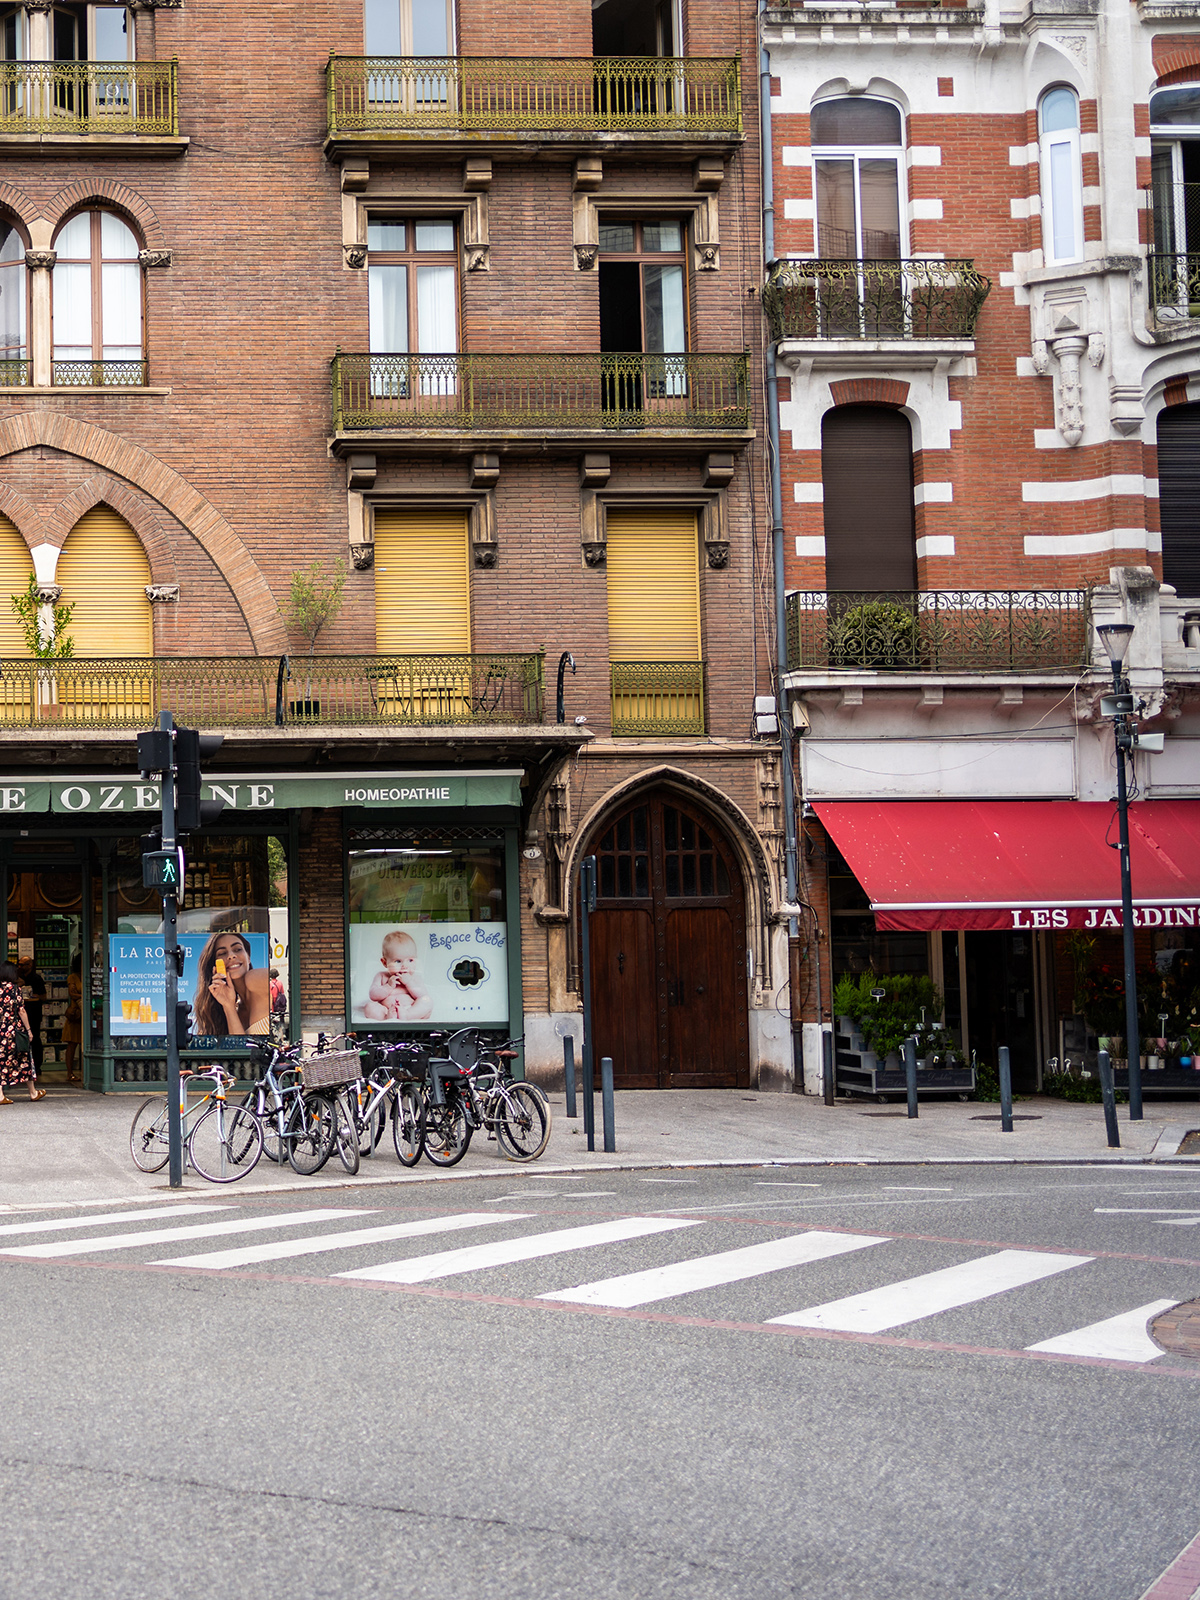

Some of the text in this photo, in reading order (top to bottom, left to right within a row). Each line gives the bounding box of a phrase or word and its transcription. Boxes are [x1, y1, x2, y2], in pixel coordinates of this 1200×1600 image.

[60, 784, 276, 811] OZENE
[344, 787, 450, 801] HOMEOPATHIE
[1011, 906, 1200, 929] LES JARDIN
[429, 927, 506, 950] Espace Bébé
[120, 946, 193, 959] LA ROE
